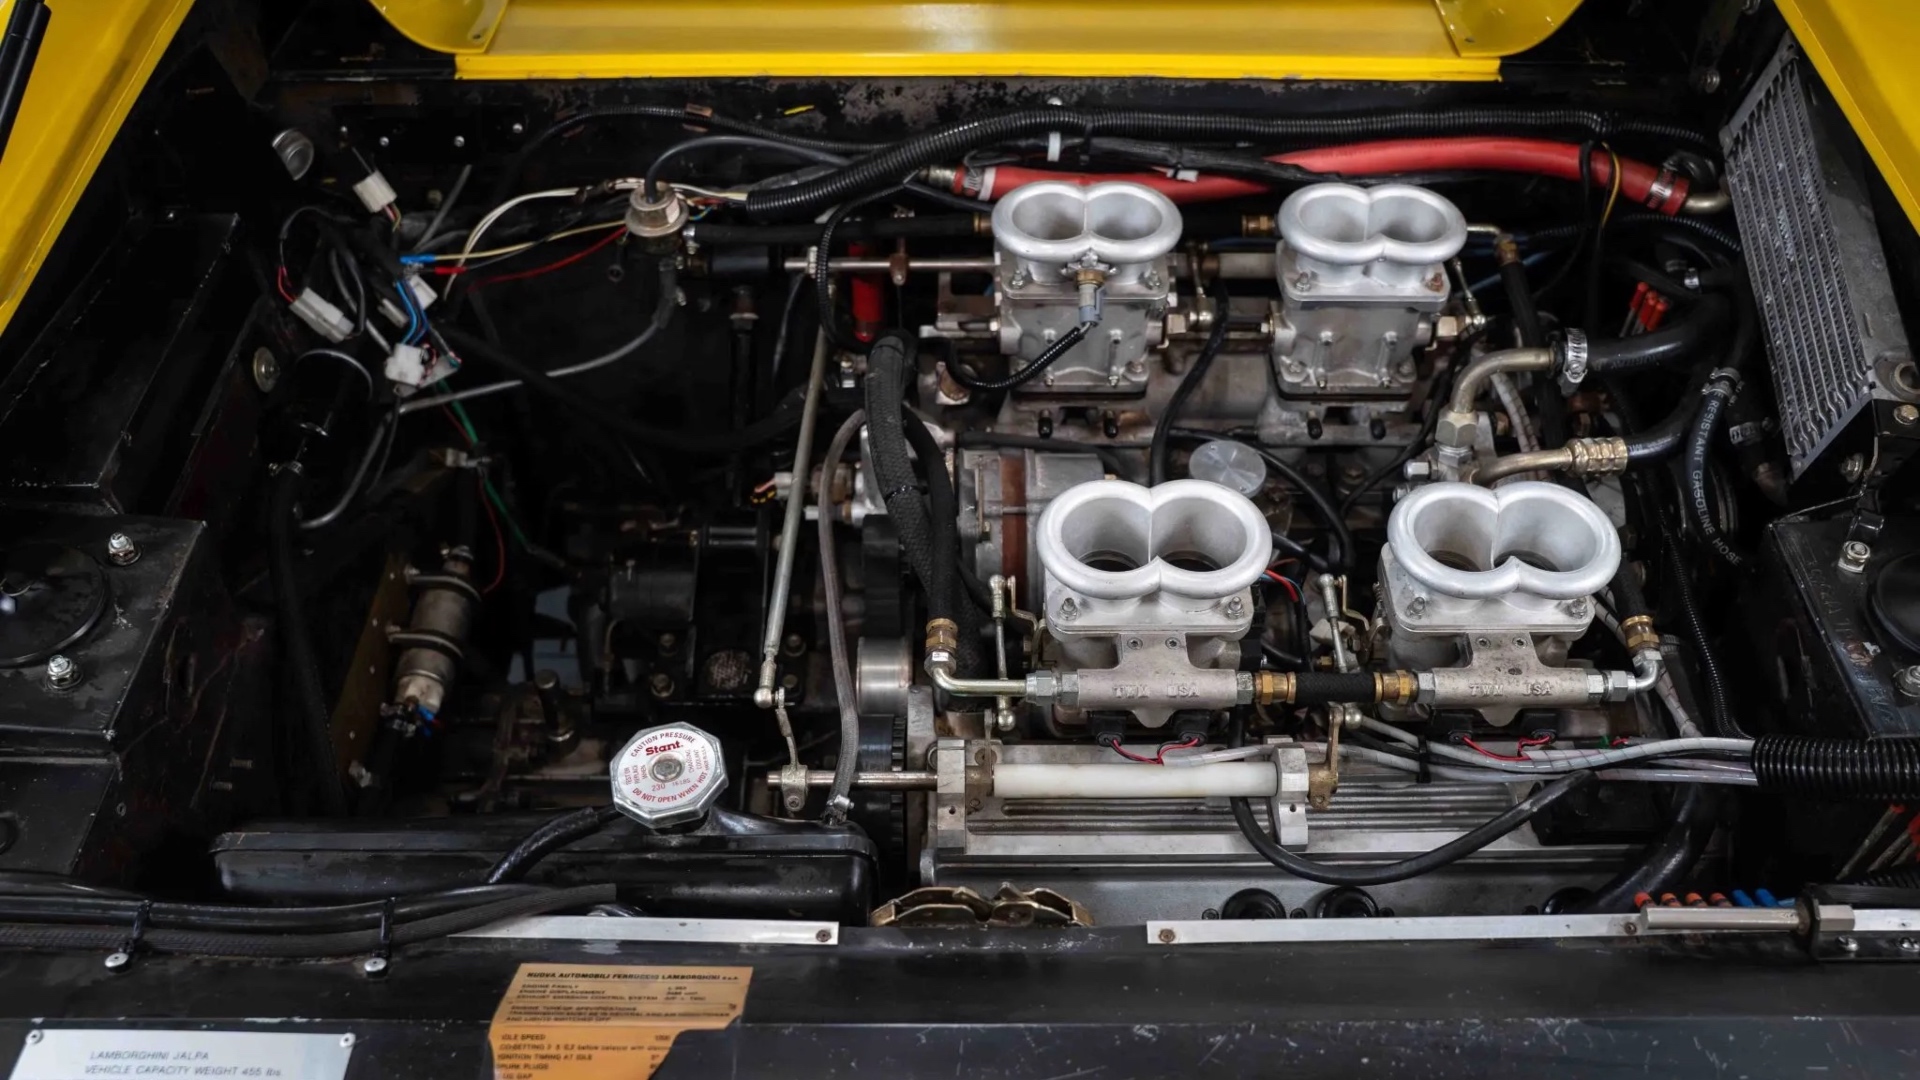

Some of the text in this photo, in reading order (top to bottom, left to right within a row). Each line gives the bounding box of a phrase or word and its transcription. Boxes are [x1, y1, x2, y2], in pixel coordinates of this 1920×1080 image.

[1691, 400, 1743, 567] RESISTANT GASOLINE HOSE
[1167, 682, 1200, 697] USA
[1468, 682, 1504, 697] TWM
[630, 731, 697, 758] CAUTION PRESSURE
[645, 740, 681, 756] Stant
[632, 771, 708, 803] DO NOT OPEN WHEN HOT
[651, 783, 666, 792] 230
[90, 1051, 210, 1061] LAMBORGHINI JALPA
[85, 1064, 131, 1075] VEHICLE
[135, 1065, 190, 1075] CAPACITY
[194, 1066, 238, 1076] WEIGHT
[241, 1067, 262, 1076] 455
